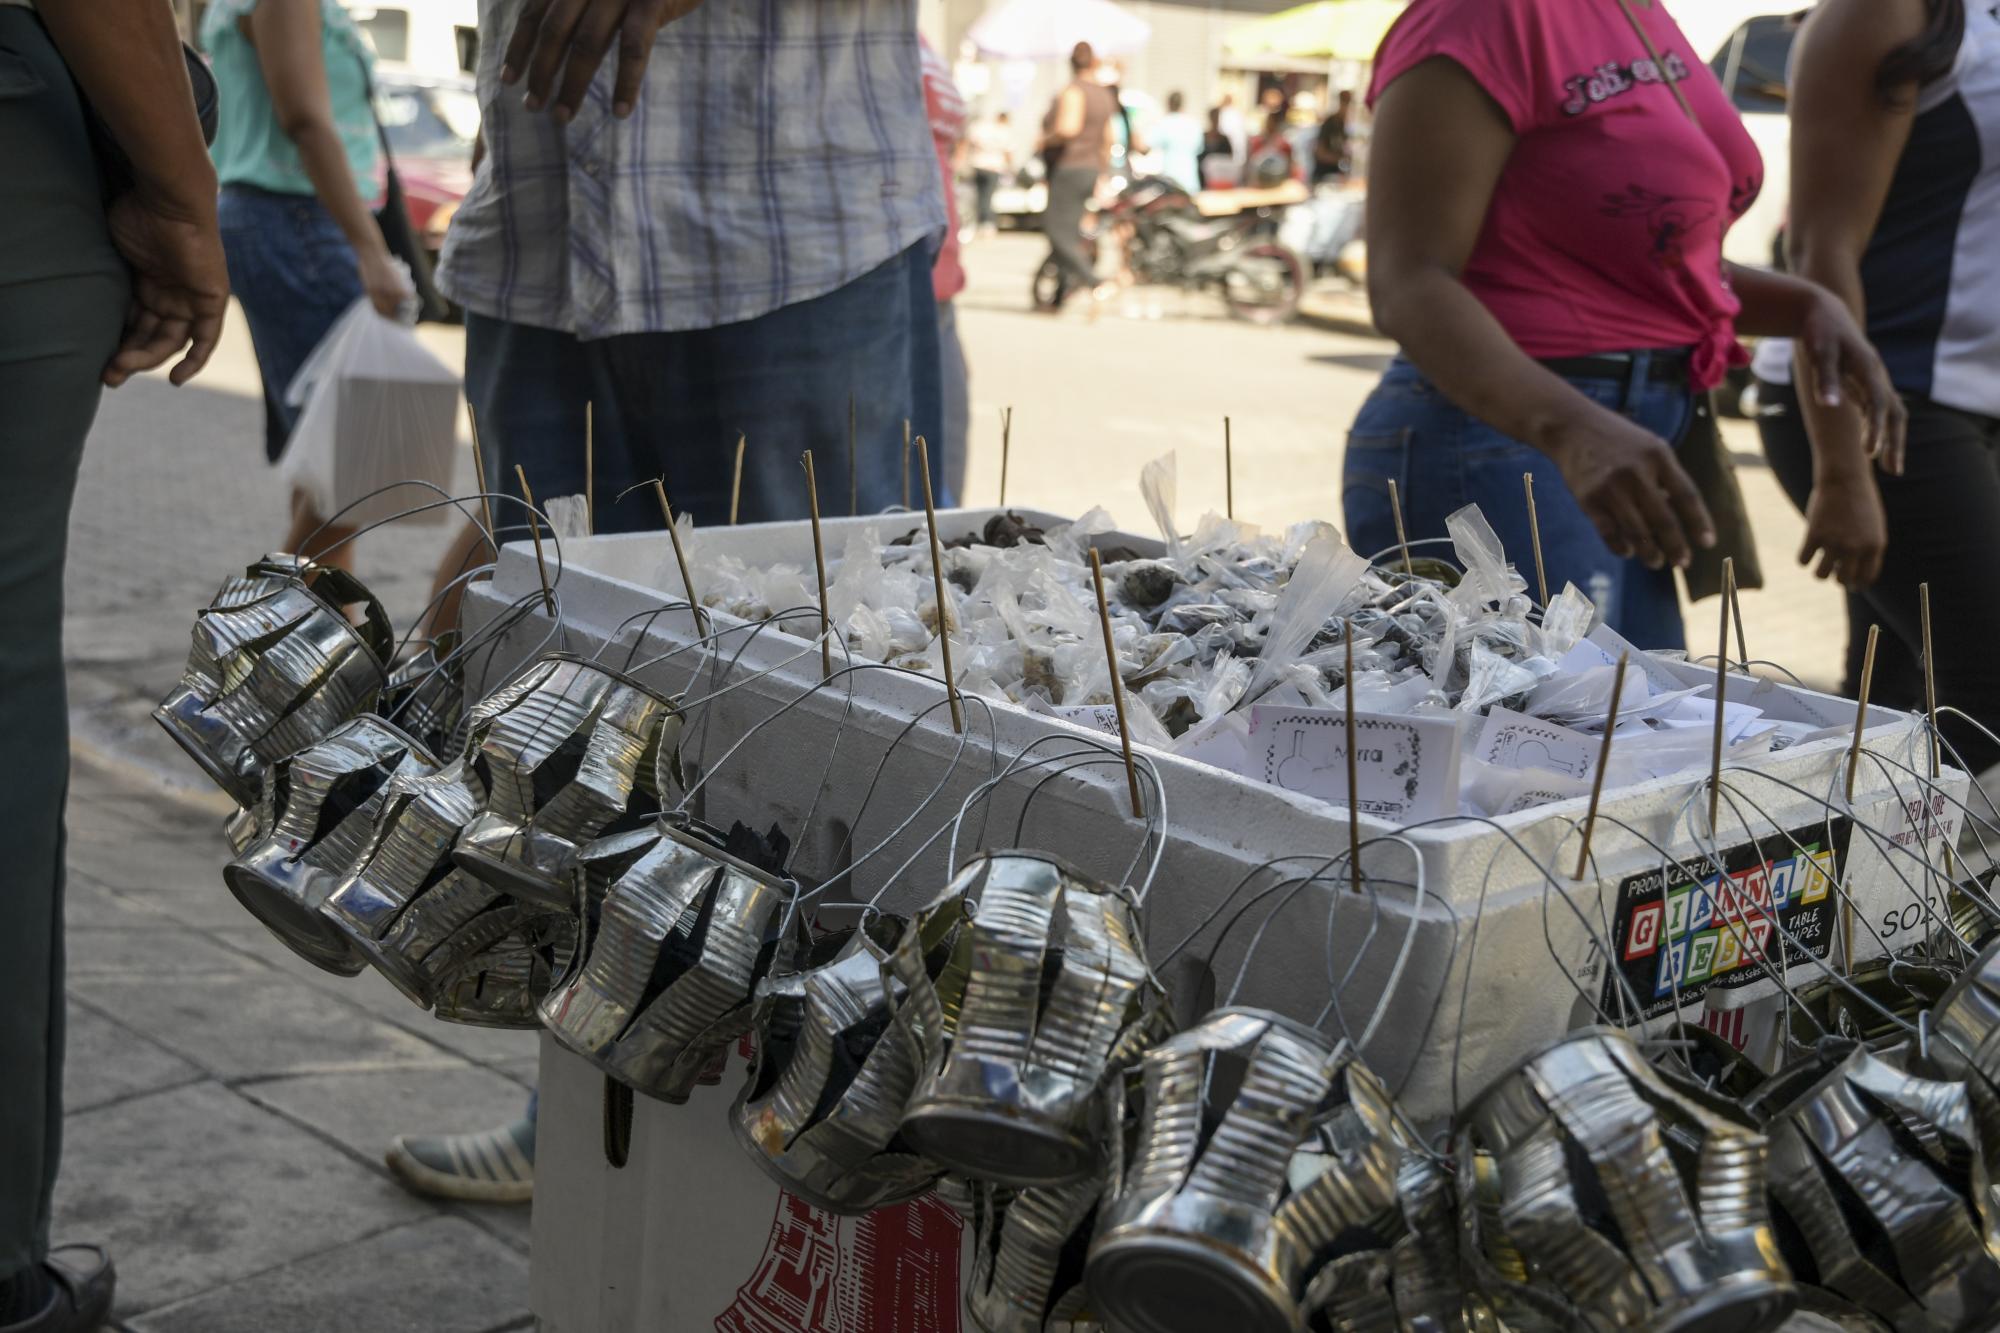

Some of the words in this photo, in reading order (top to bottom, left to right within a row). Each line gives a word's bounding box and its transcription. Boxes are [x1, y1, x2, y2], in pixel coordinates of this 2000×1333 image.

[1334, 746, 1383, 763] Mrra
[1905, 800, 1922, 824] RED
[1627, 869, 1685, 898] PRODUCE
[1633, 848, 1831, 949] GIANNA'S
[1788, 907, 1820, 930] TABLE
[1661, 913, 1772, 984] BEST
